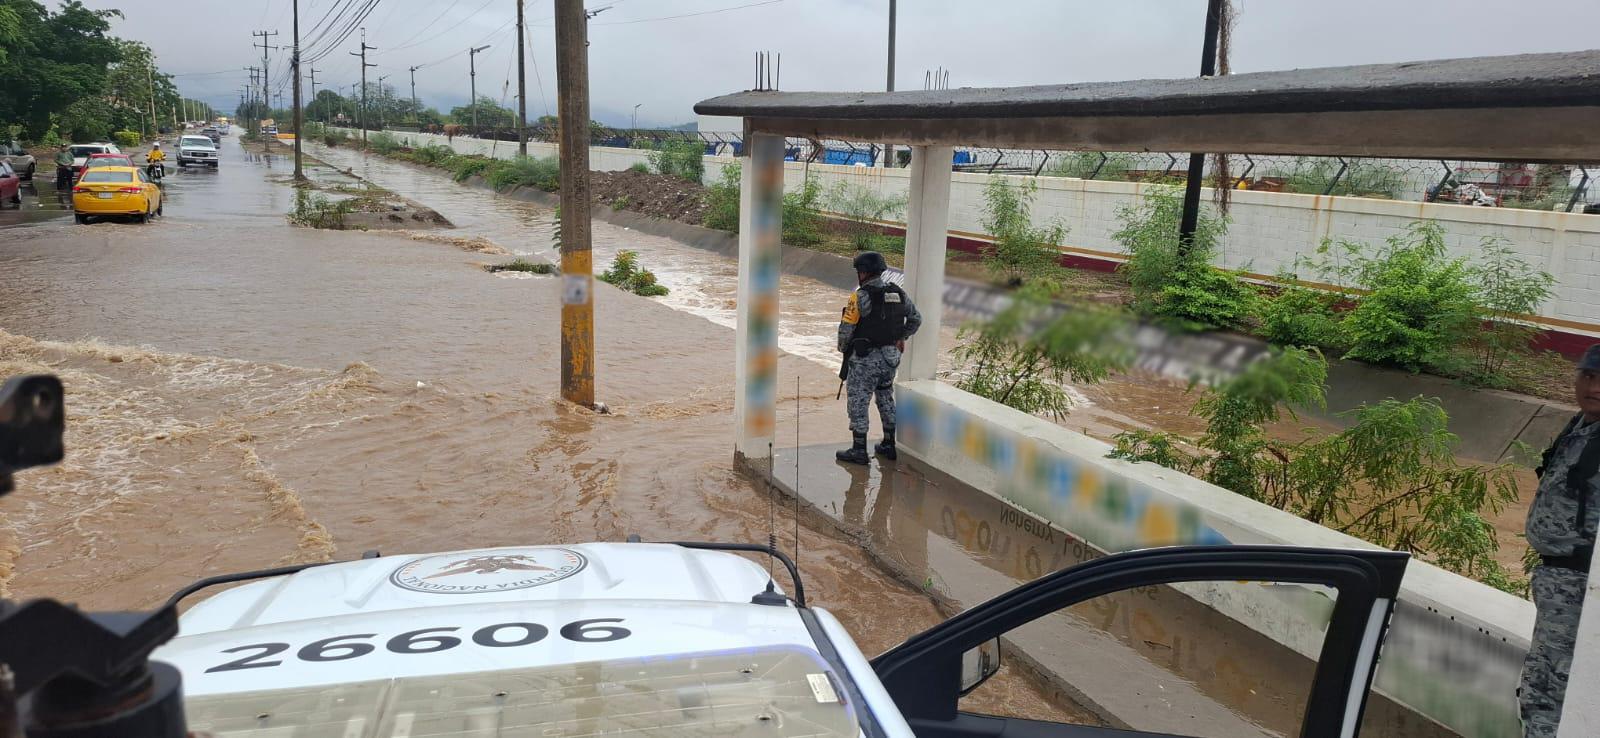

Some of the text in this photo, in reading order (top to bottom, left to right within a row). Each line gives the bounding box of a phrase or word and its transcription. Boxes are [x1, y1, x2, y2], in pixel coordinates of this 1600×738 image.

[402, 565, 574, 591] GUARDIA NACIONAL
[204, 618, 632, 673] 26606
